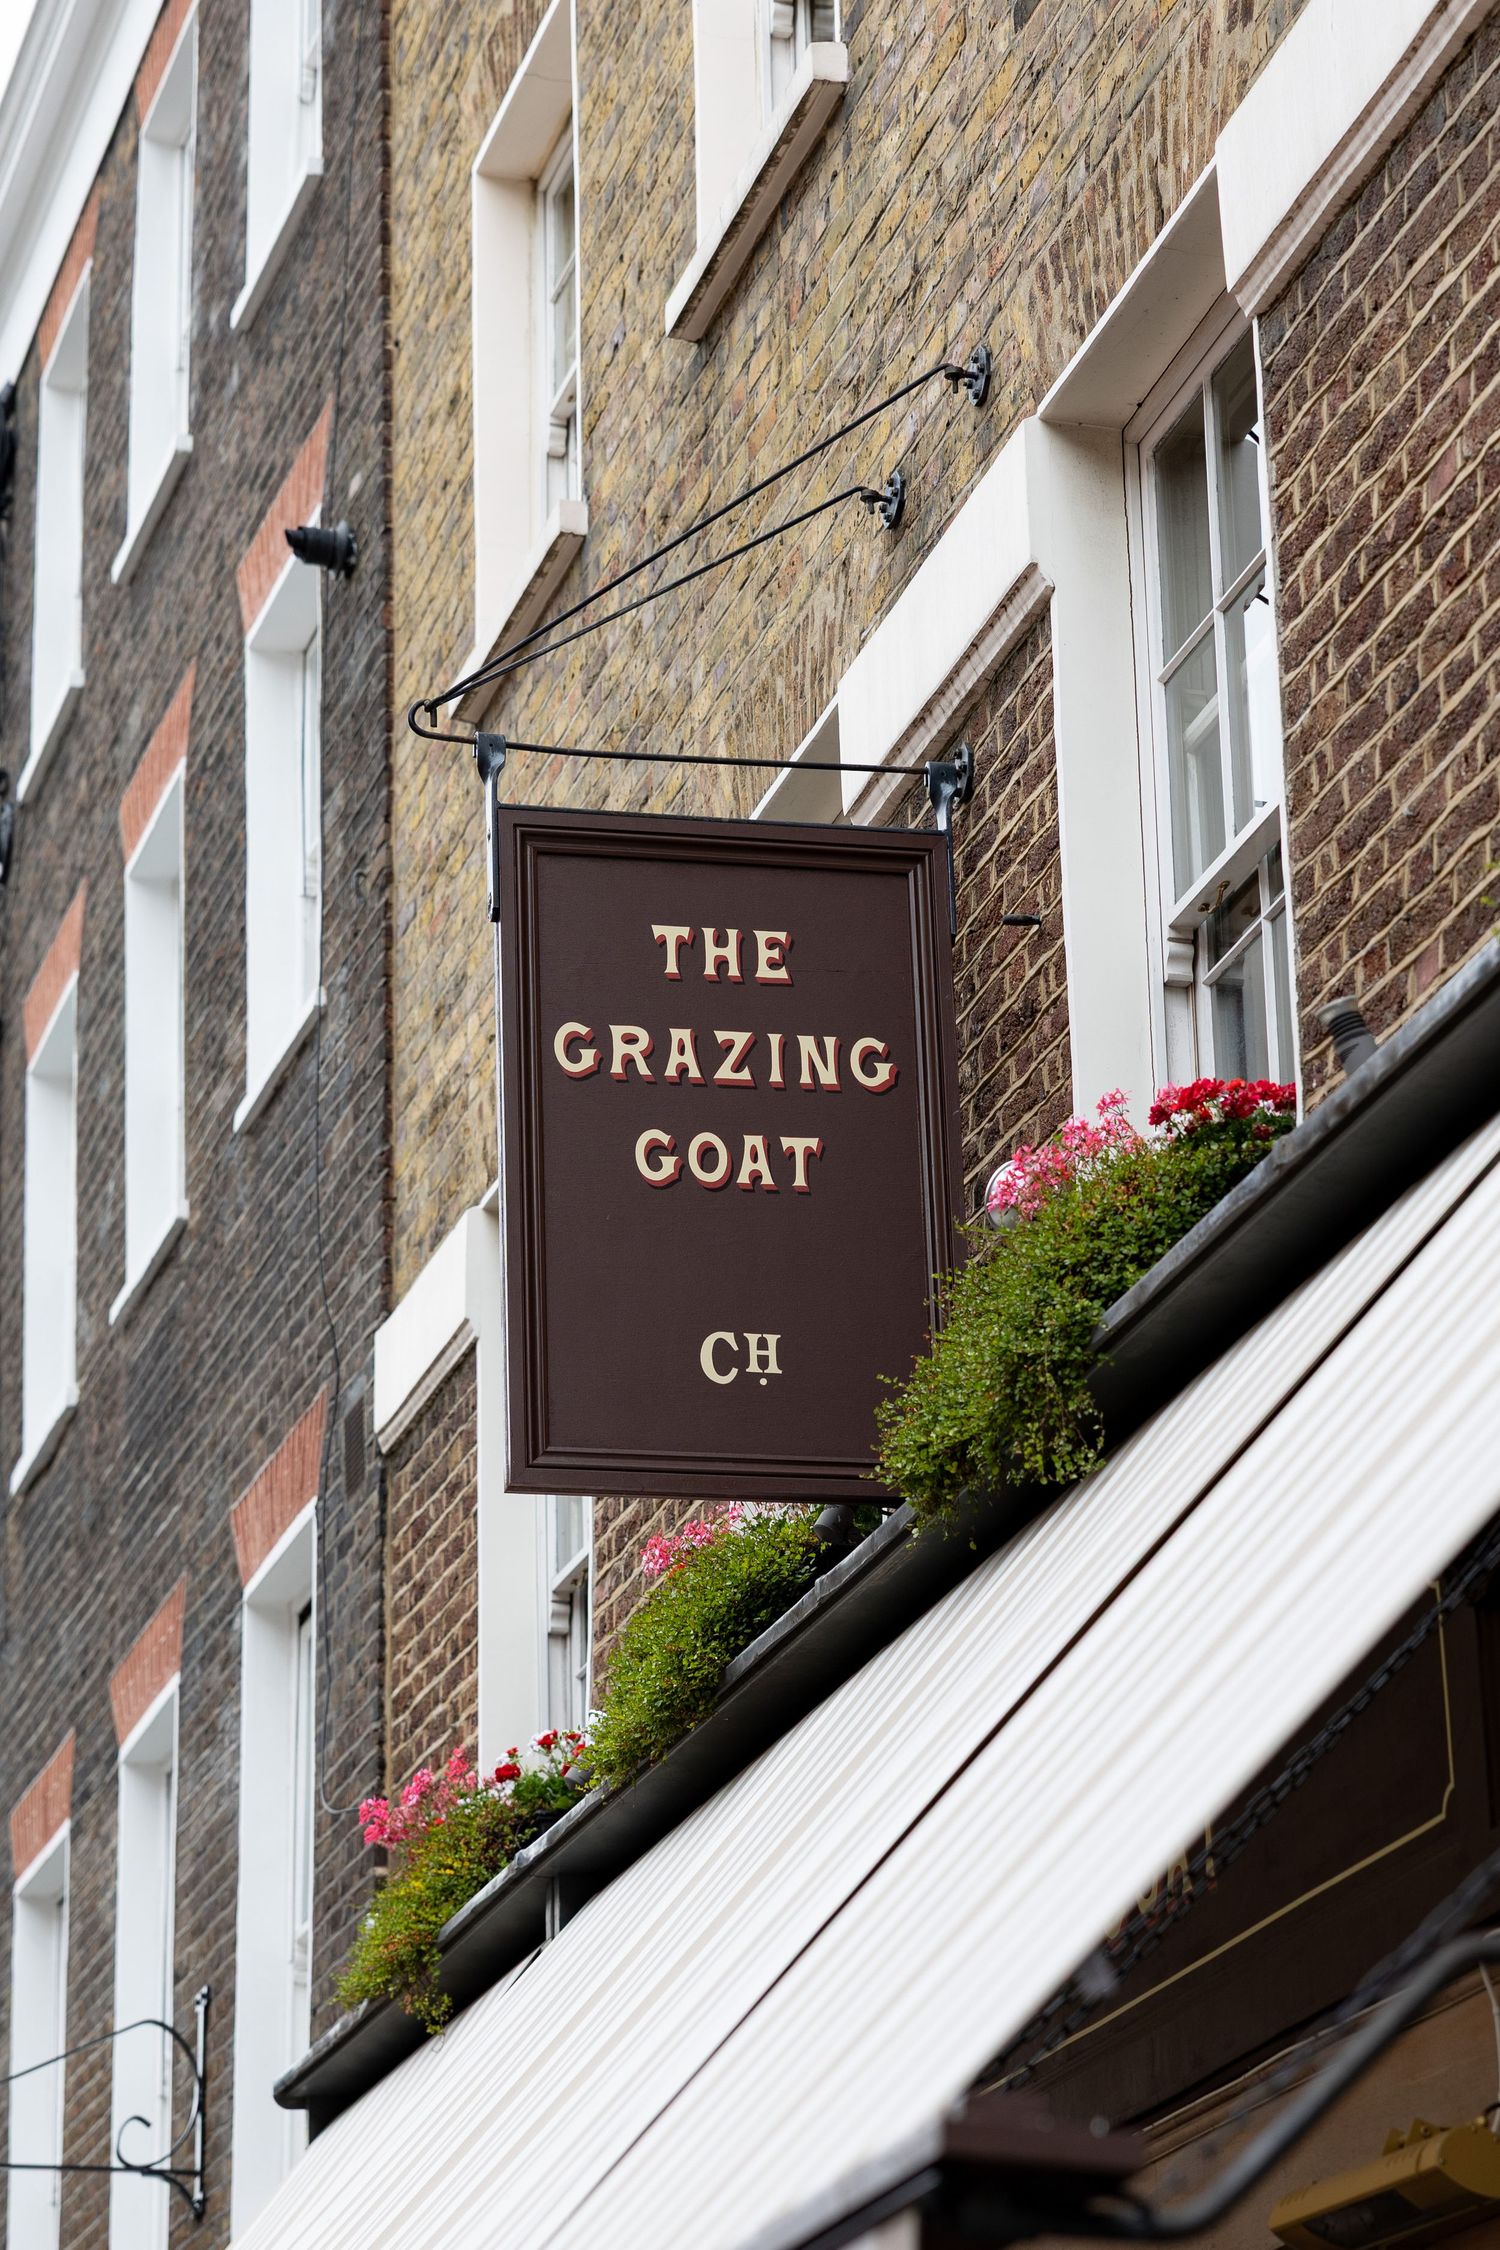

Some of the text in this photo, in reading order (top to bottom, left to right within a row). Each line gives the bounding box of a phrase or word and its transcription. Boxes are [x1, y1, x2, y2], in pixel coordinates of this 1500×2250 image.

[651, 925, 793, 984] THE
[554, 1022, 898, 1093] GRAZING
[635, 1129, 823, 1193] GOAT
